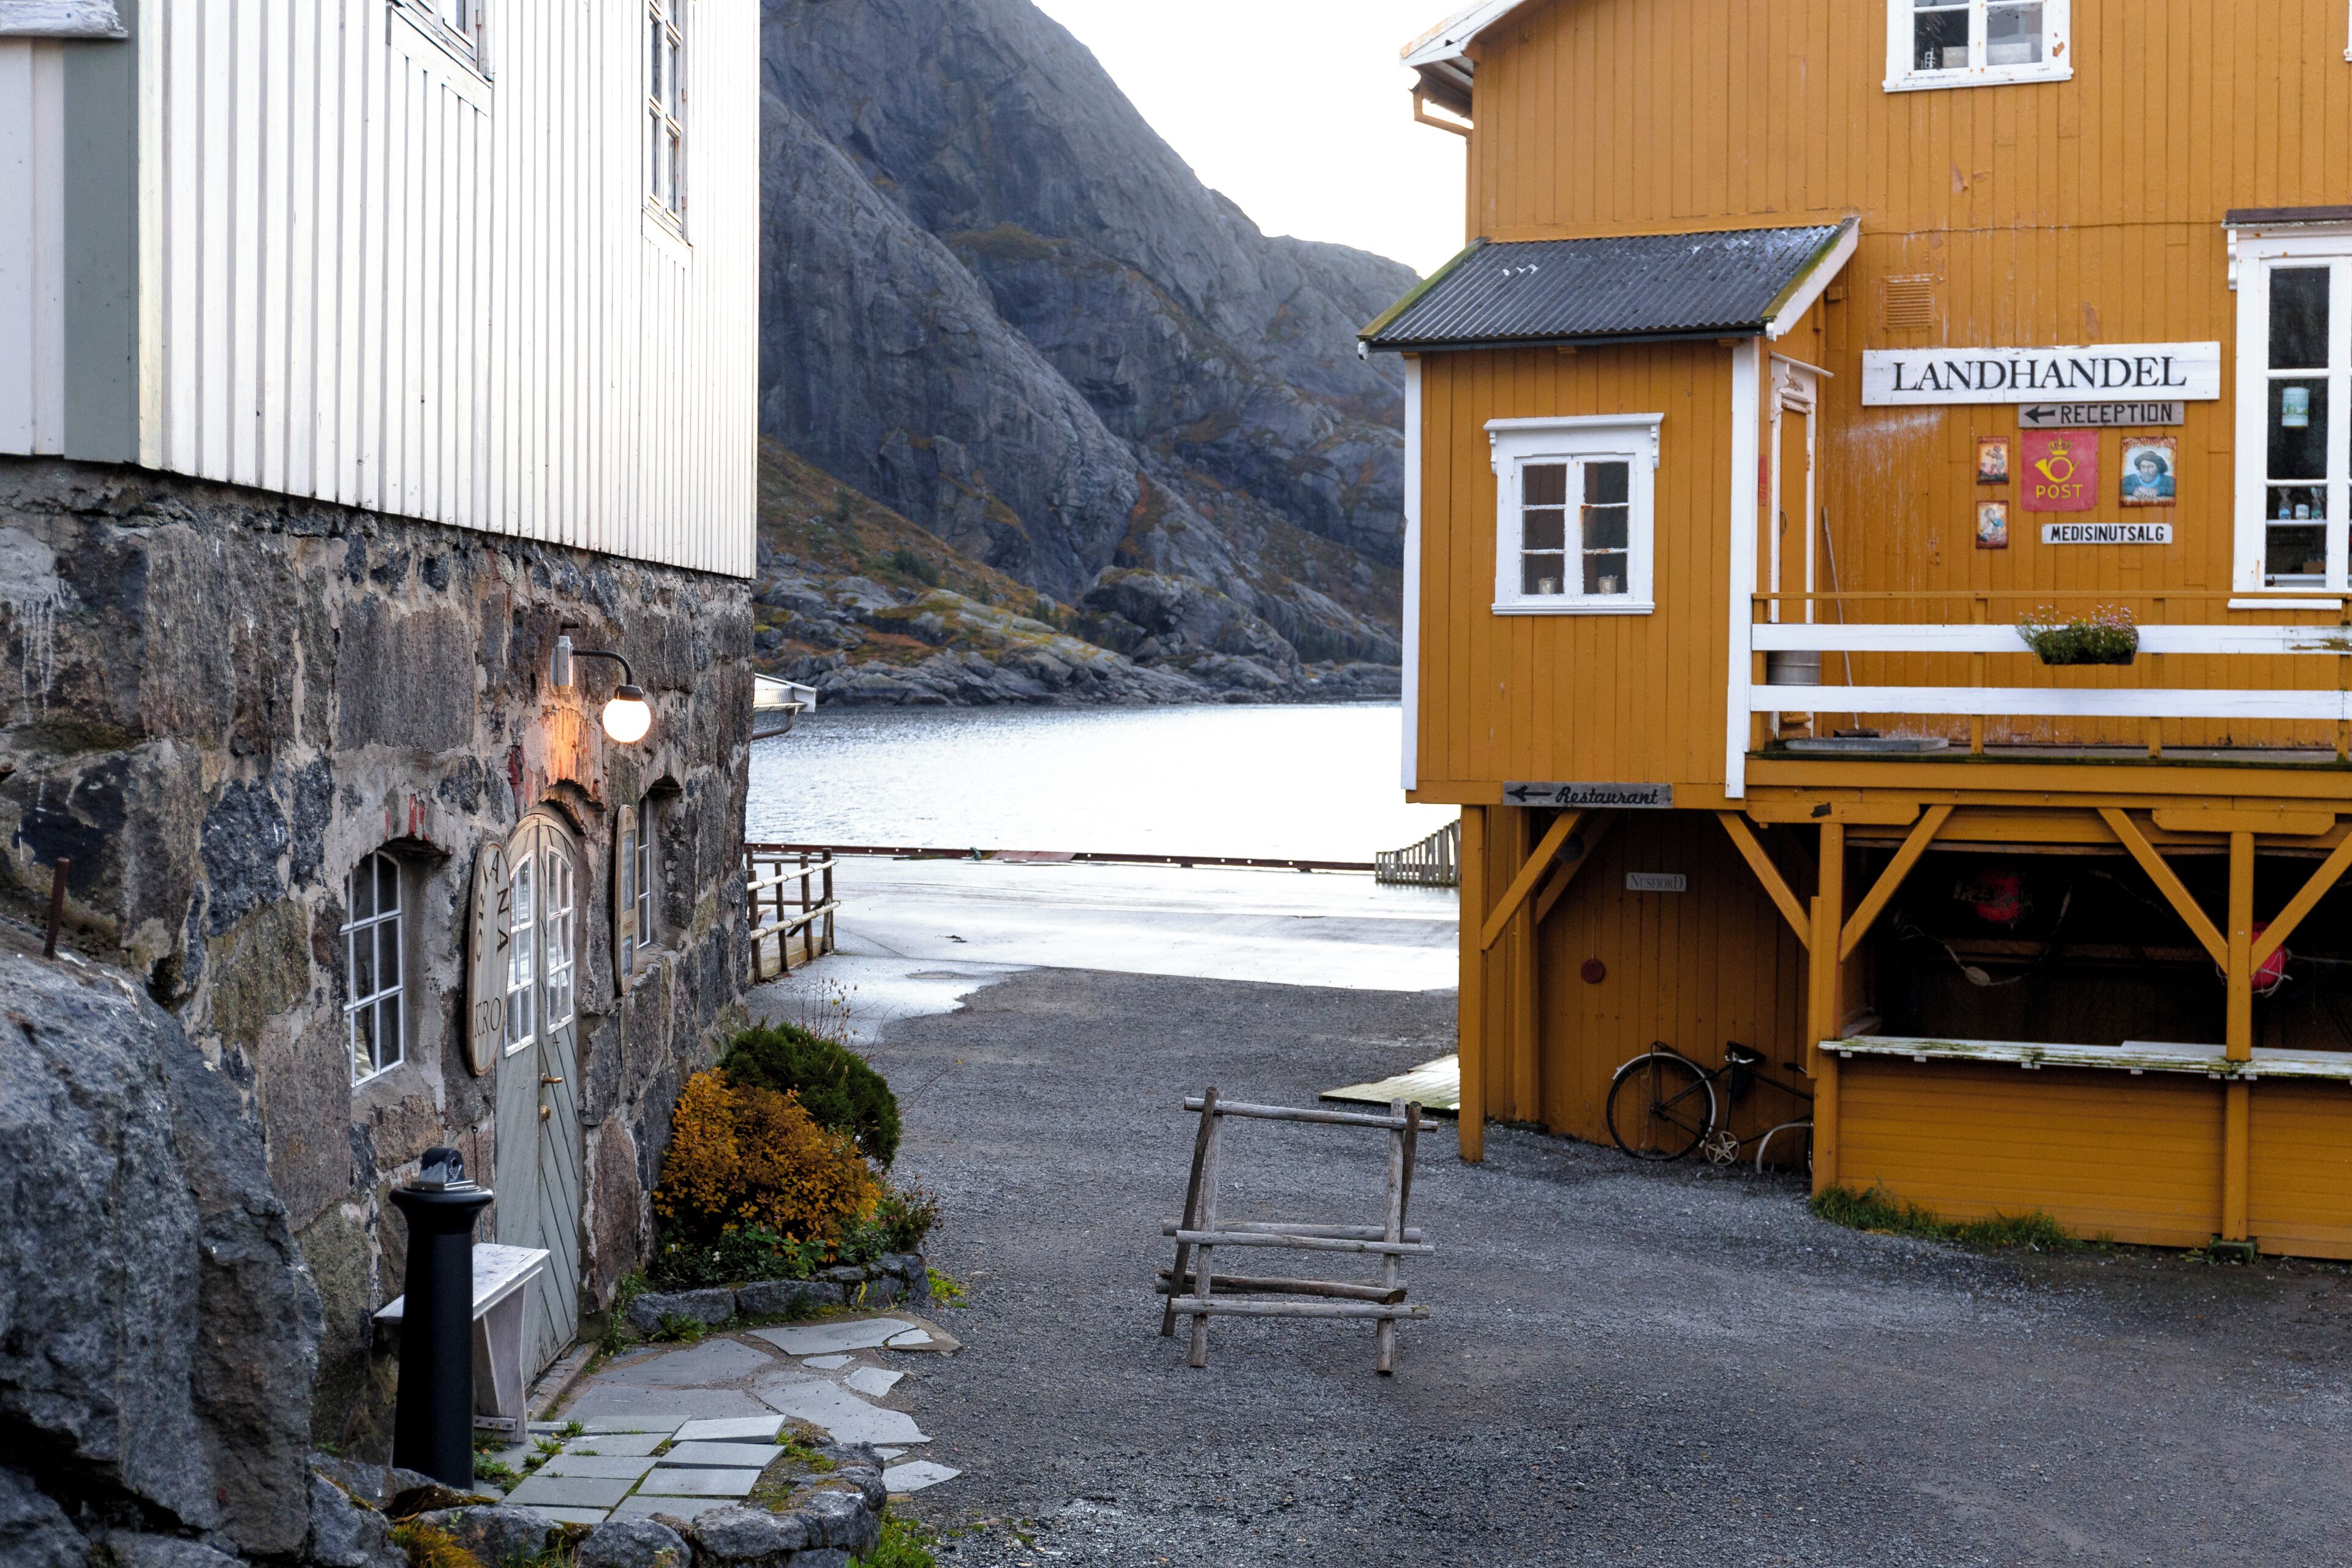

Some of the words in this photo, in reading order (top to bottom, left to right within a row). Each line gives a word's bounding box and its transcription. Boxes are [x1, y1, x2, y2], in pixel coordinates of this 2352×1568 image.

[1891, 356, 2187, 391] LANDHANDEL
[2060, 403, 2173, 424] RECEPTION
[2035, 484, 2083, 499] POST
[2050, 525, 2165, 543] MEDISINUTSALG
[1555, 786, 1658, 805] Restaurant
[474, 997, 502, 1038] KRO
